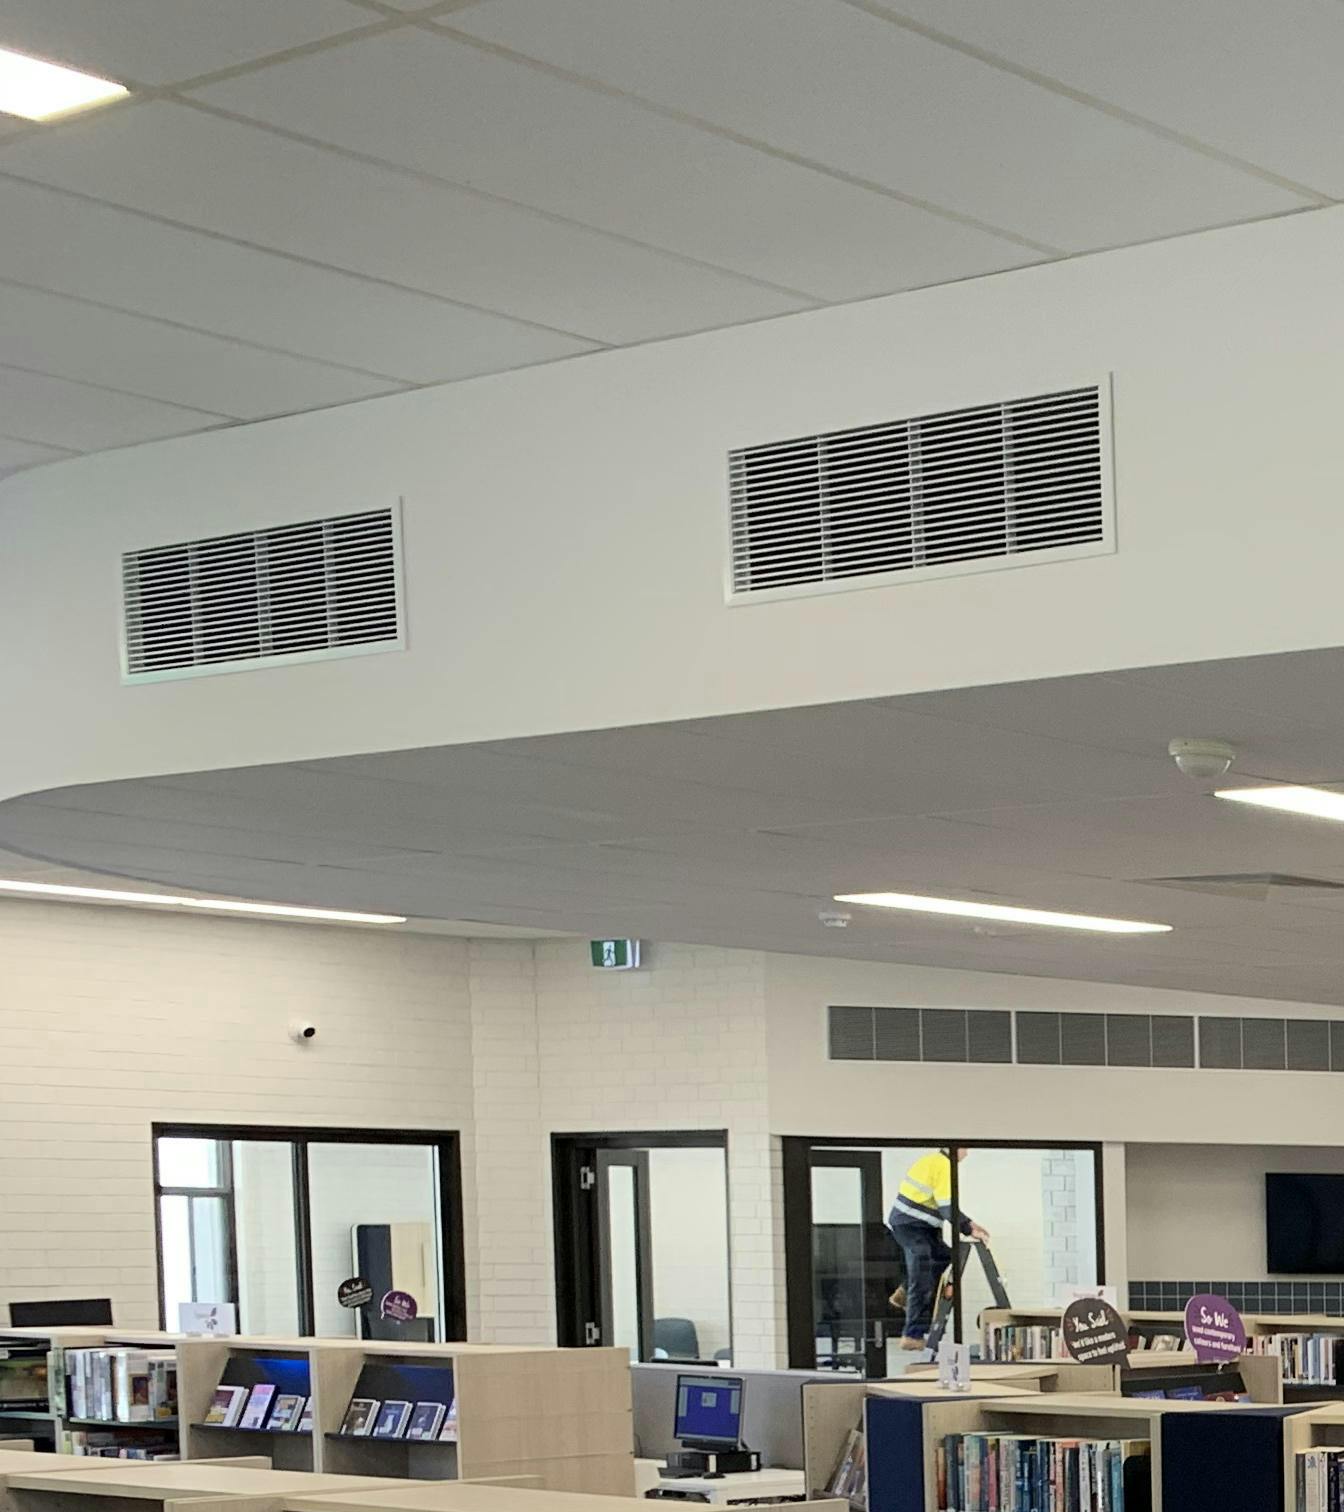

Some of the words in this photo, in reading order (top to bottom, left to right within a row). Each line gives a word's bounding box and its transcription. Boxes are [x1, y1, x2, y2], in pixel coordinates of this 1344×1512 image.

[1072, 1316, 1088, 1333] You
[1088, 1309, 1109, 1327] Said
[1200, 1306, 1213, 1325] So
[1214, 1311, 1229, 1329] We
